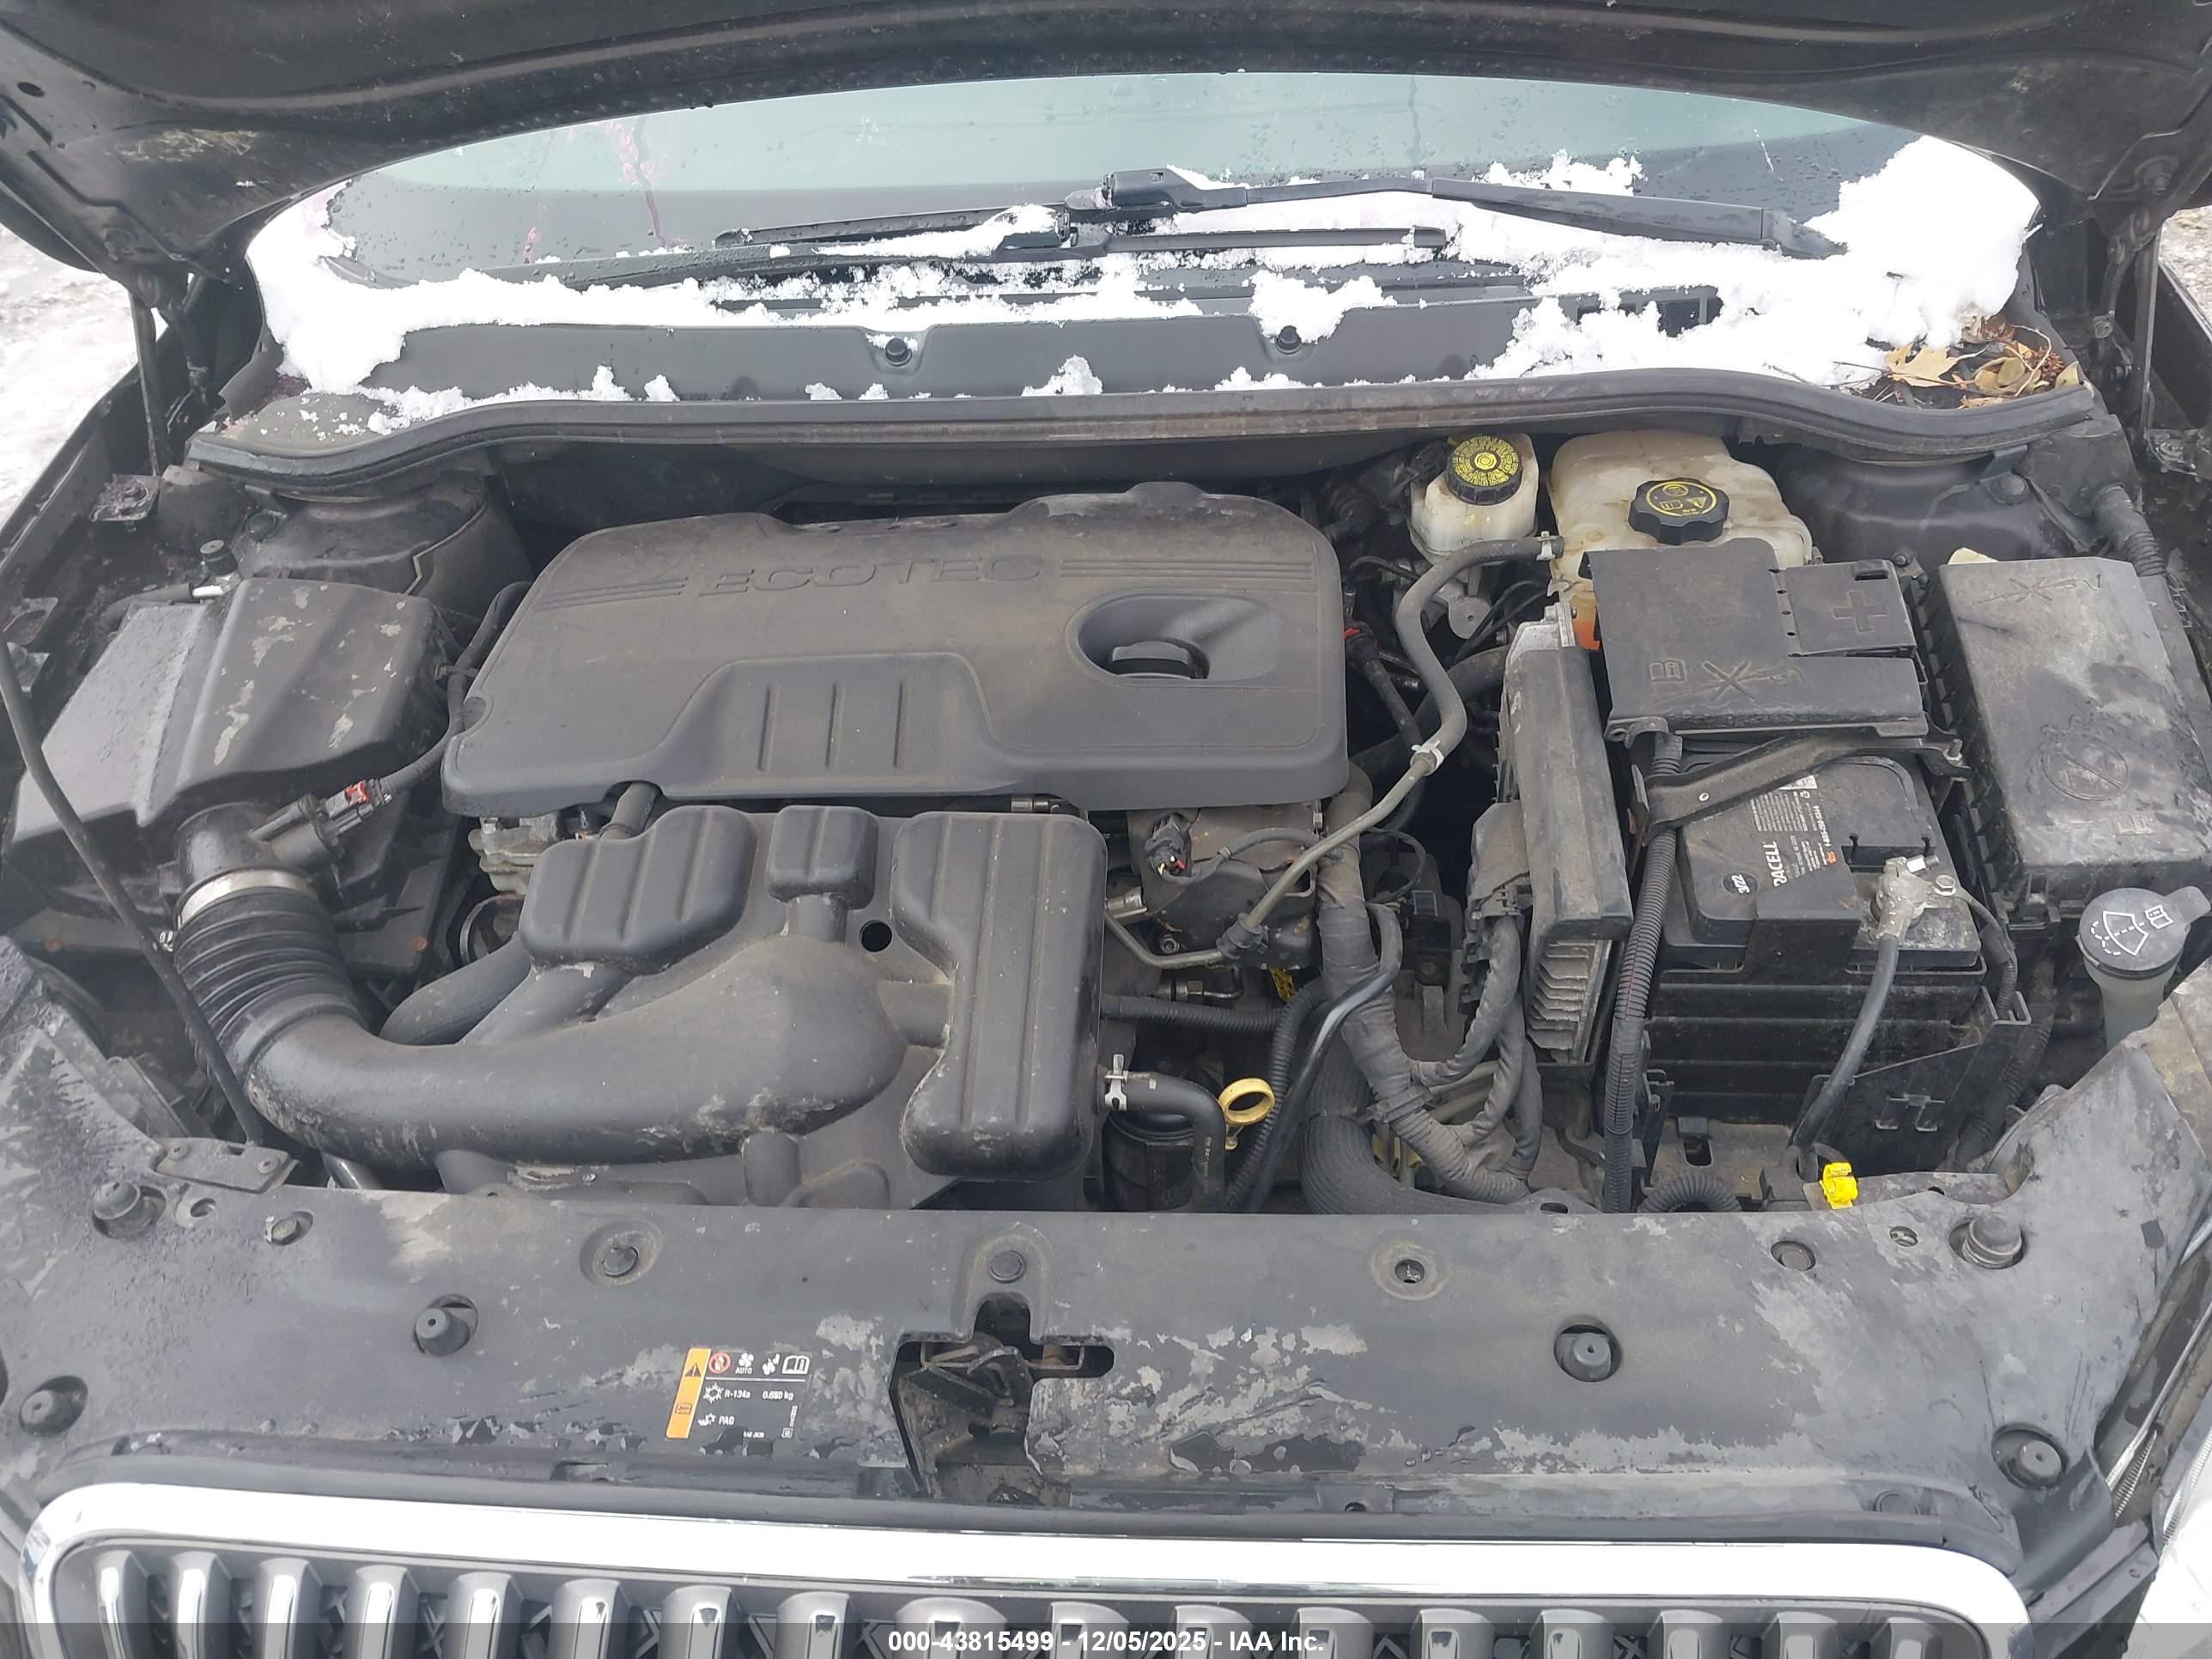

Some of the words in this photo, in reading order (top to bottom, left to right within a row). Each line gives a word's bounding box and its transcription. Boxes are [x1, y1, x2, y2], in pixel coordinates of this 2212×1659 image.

[697, 555, 1045, 598] ECOTEC
[724, 1389, 750, 1399] R-134a
[783, 1391, 794, 1401] kg
[718, 1416, 734, 1425] PAG
